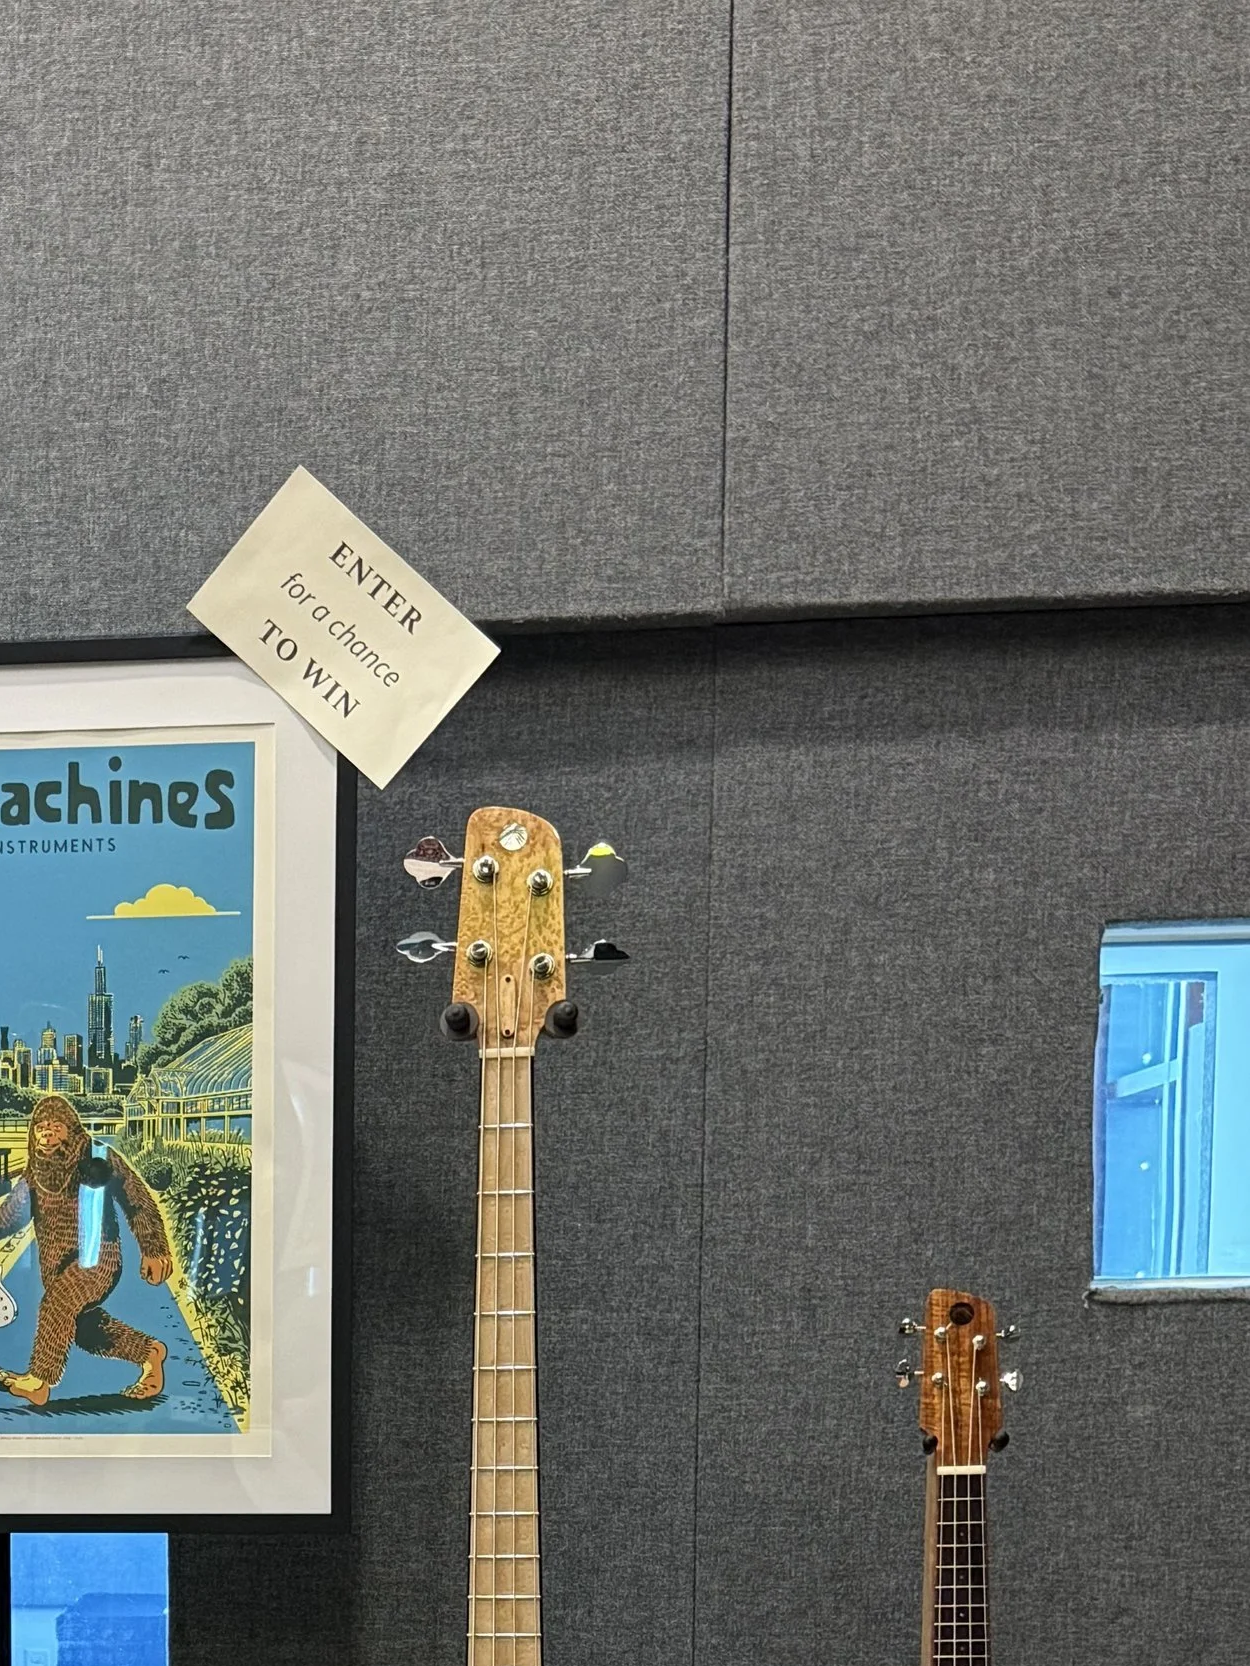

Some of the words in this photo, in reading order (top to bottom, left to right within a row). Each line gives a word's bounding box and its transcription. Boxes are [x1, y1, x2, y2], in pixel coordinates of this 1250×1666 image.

[280, 572, 316, 606] for
[312, 605, 330, 622] a
[328, 620, 400, 687] chance
[328, 540, 422, 635] ENTER
[258, 618, 298, 662] TO
[302, 657, 361, 718] WIN
